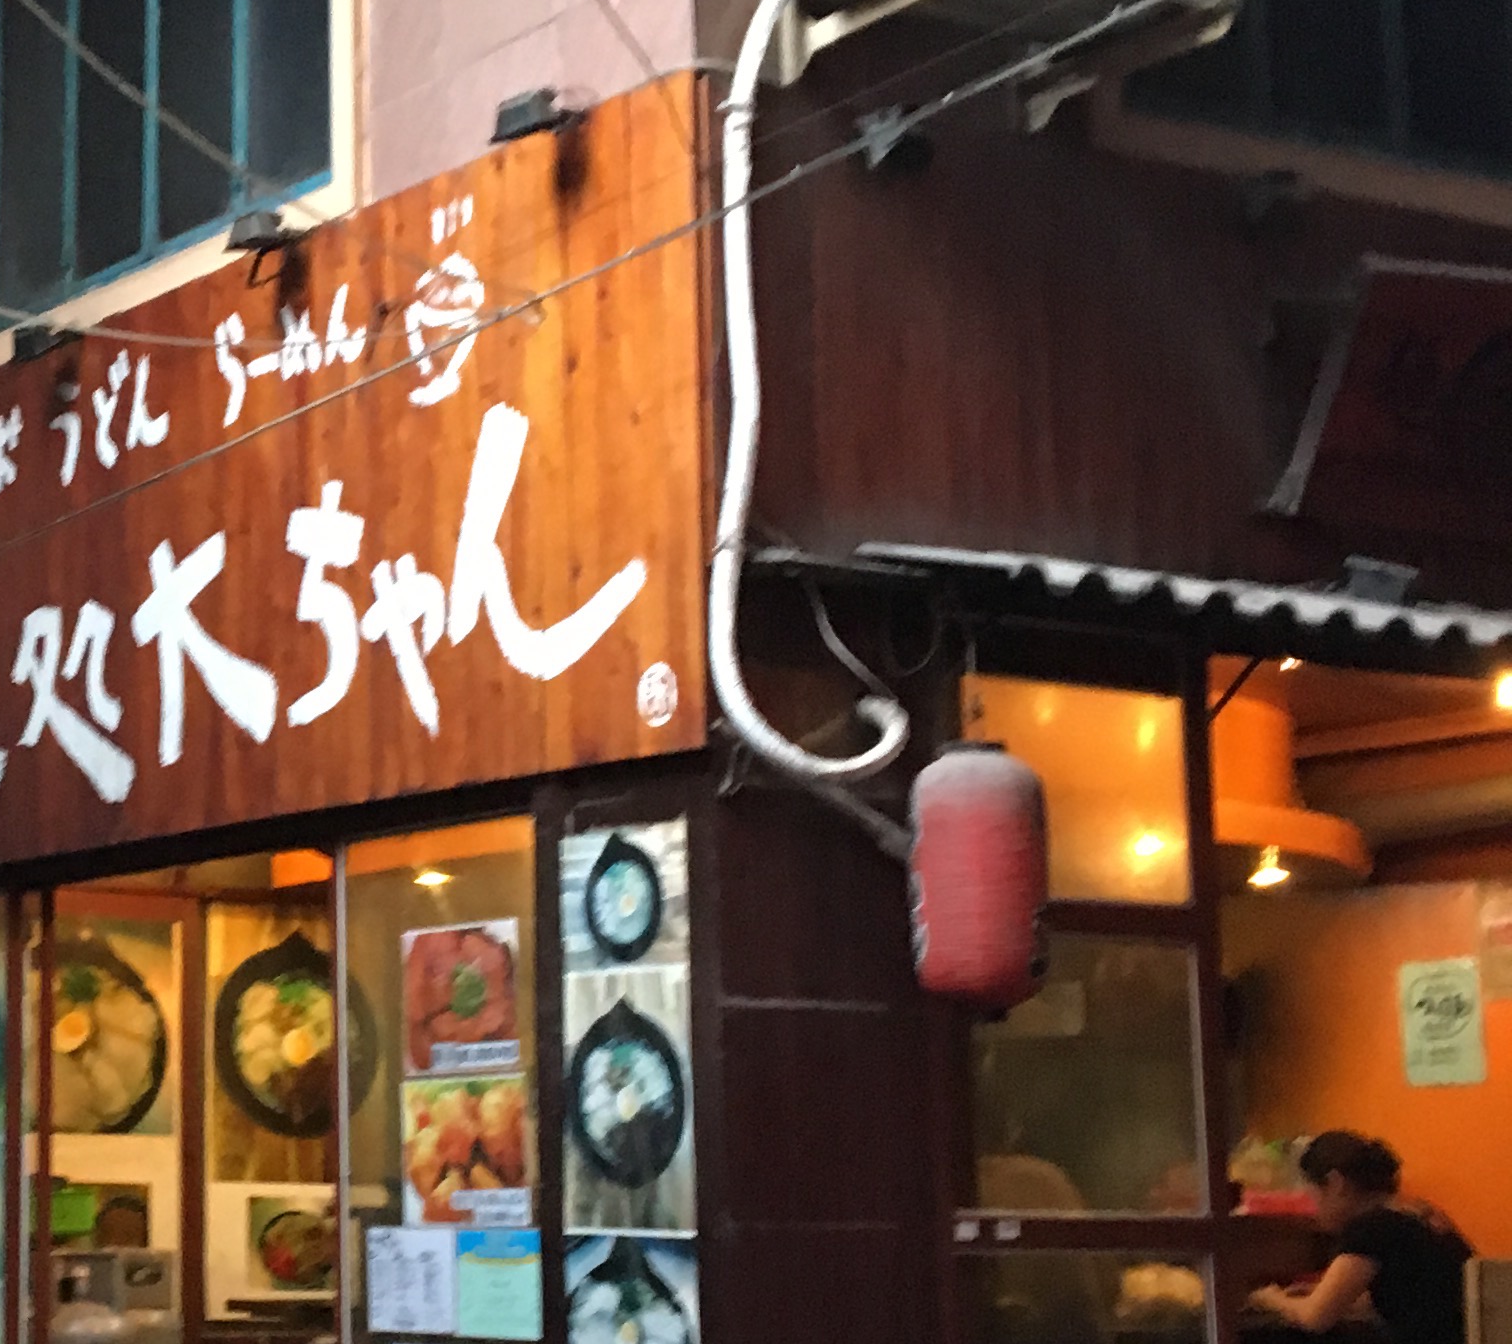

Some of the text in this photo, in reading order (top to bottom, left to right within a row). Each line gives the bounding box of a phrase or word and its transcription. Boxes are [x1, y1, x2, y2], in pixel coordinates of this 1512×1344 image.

[49, 348, 170, 487] うどん
[214, 283, 367, 429] らーめん
